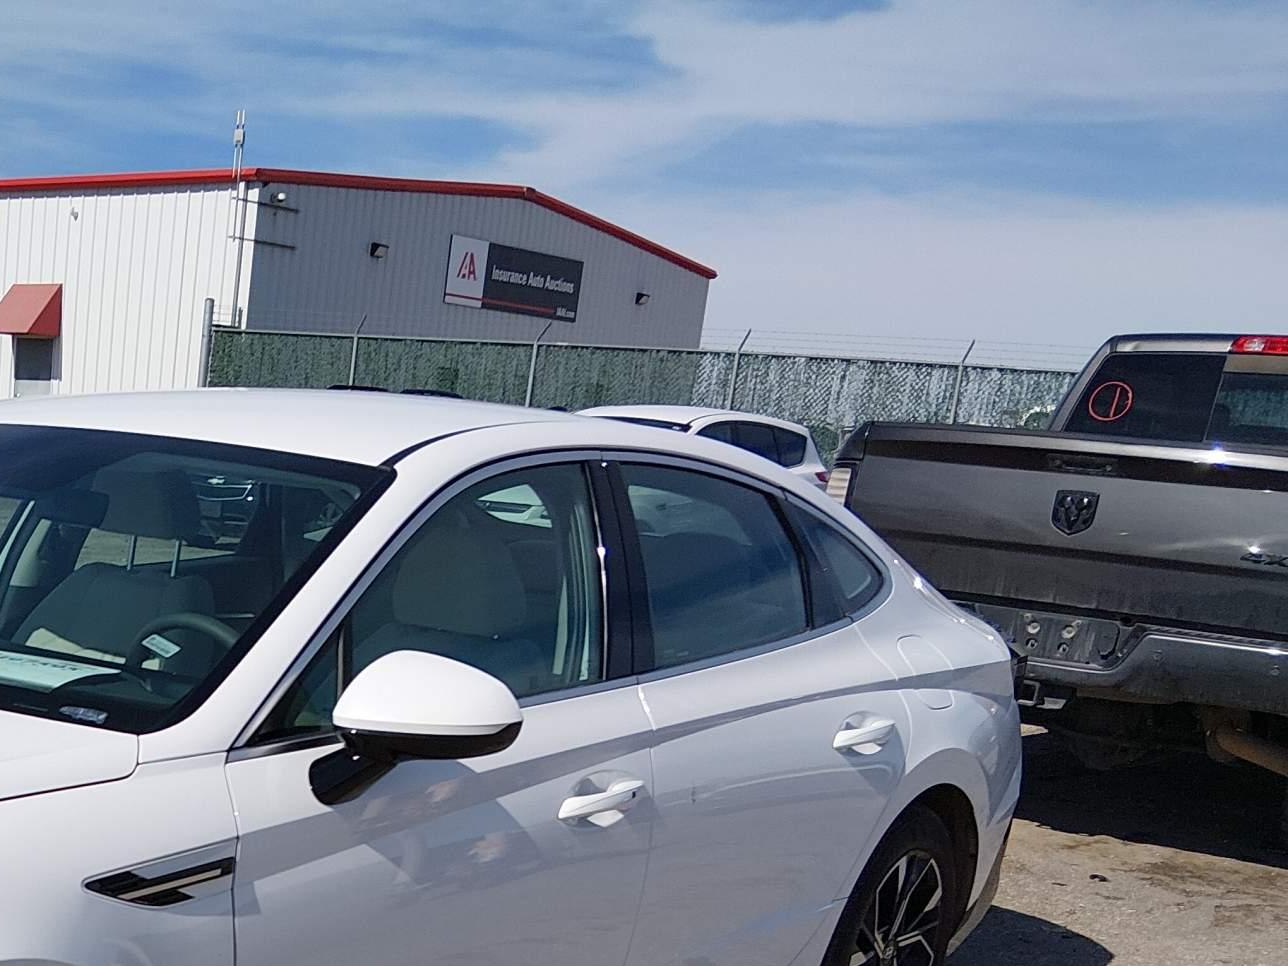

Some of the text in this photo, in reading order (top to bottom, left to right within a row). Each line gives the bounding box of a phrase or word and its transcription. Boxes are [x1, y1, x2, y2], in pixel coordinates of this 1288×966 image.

[492, 265, 574, 294] Insurance Auto Auctions
